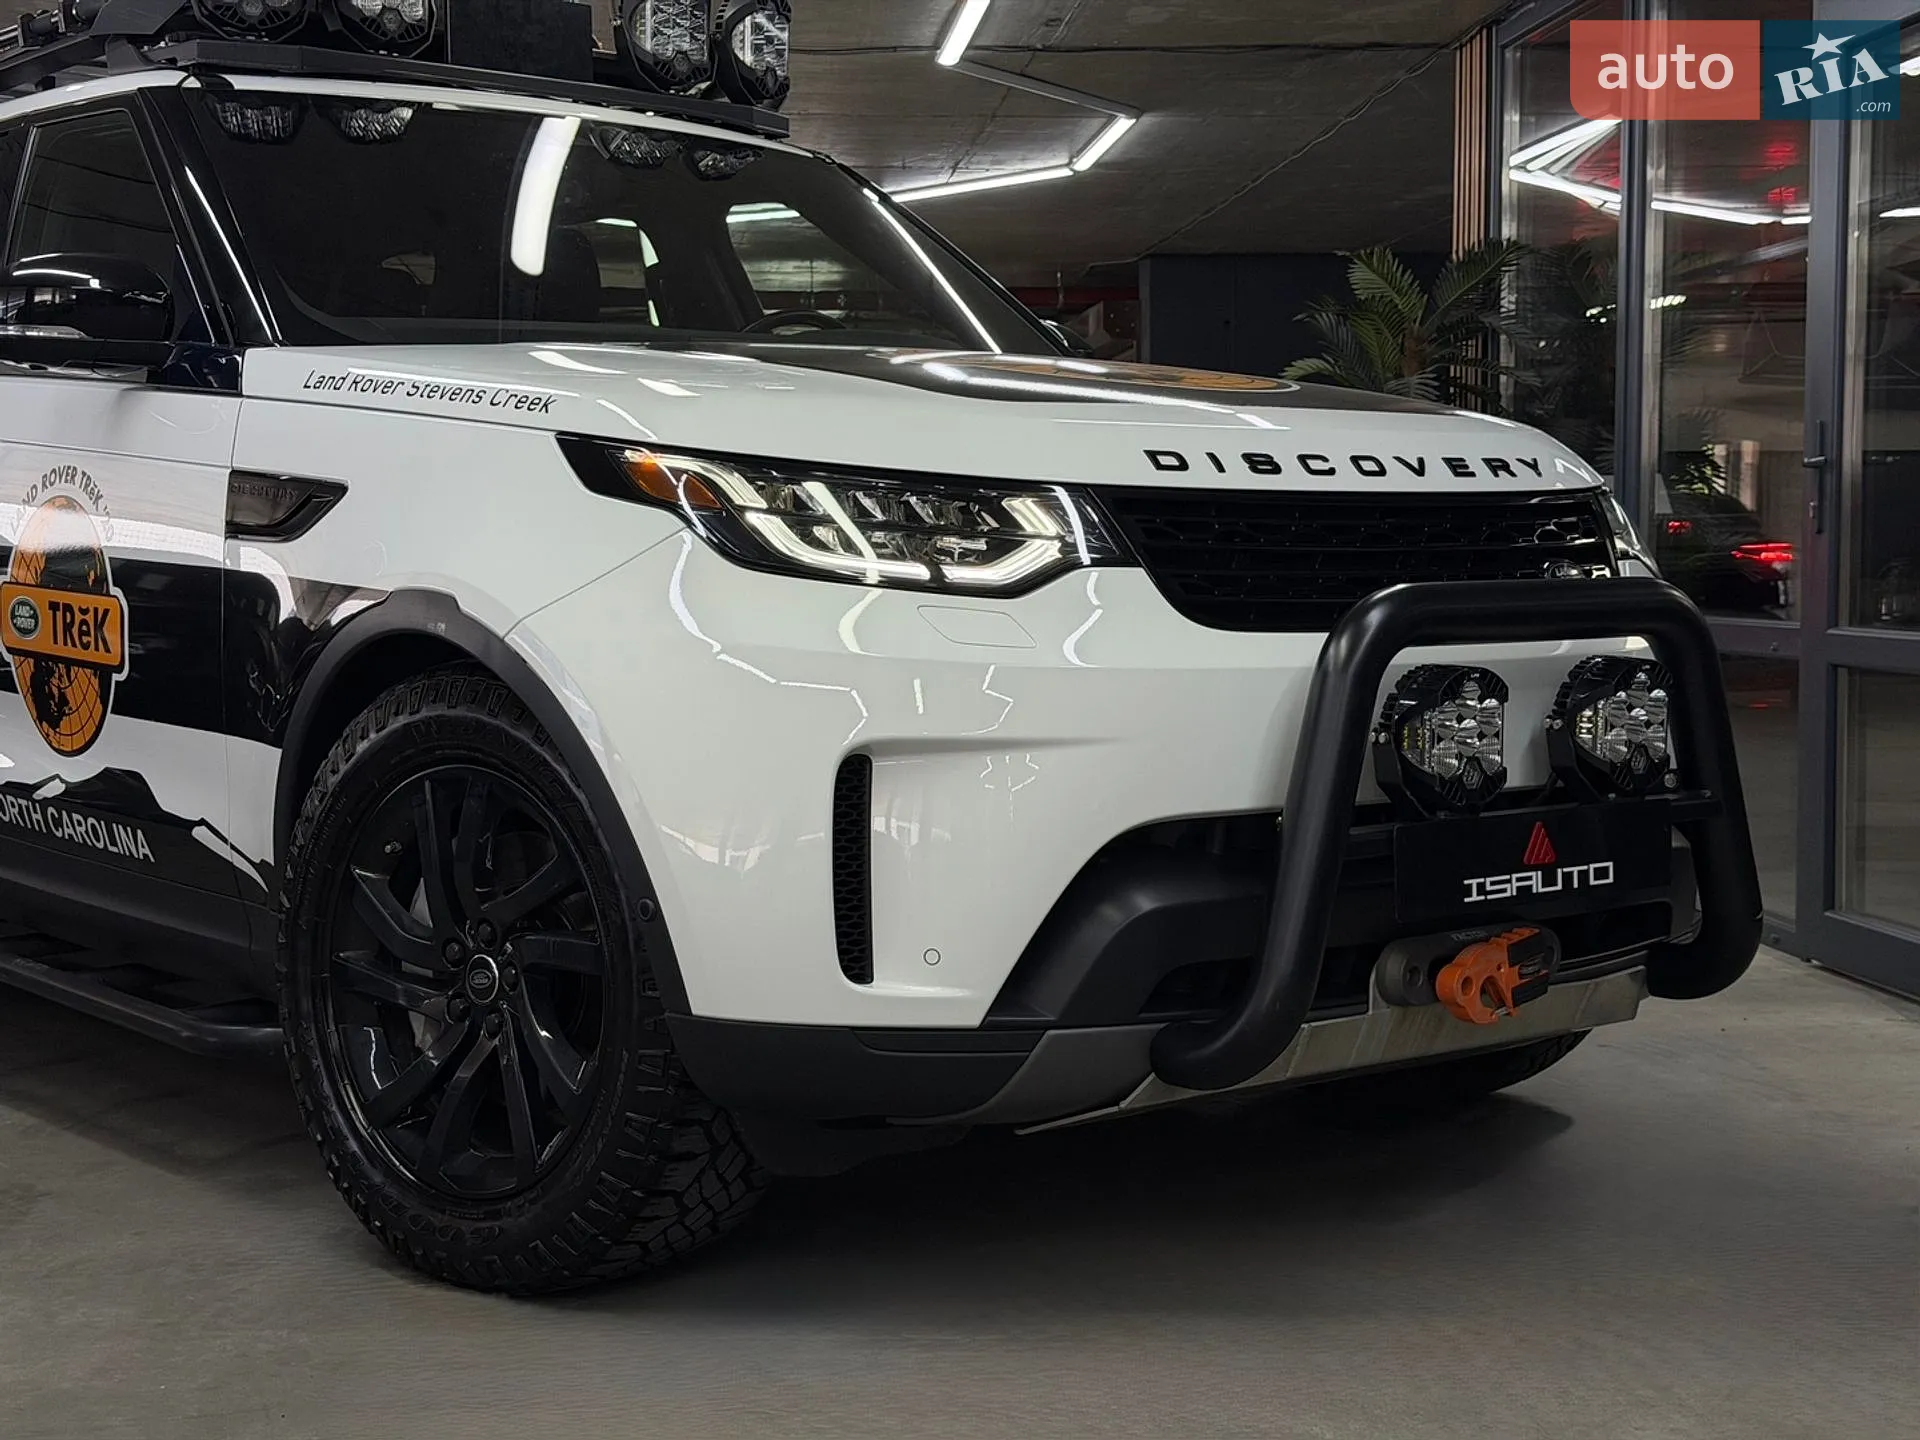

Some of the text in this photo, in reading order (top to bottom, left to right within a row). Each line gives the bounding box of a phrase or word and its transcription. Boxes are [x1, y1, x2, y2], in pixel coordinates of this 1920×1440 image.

[302, 369, 557, 414] Land Rover Stevens Creek
[41, 464, 78, 493] ROVER
[1143, 449, 1543, 478] DISCOVERY
[47, 806, 155, 863] CAROLINA
[1463, 861, 1614, 902] ISAUTO
